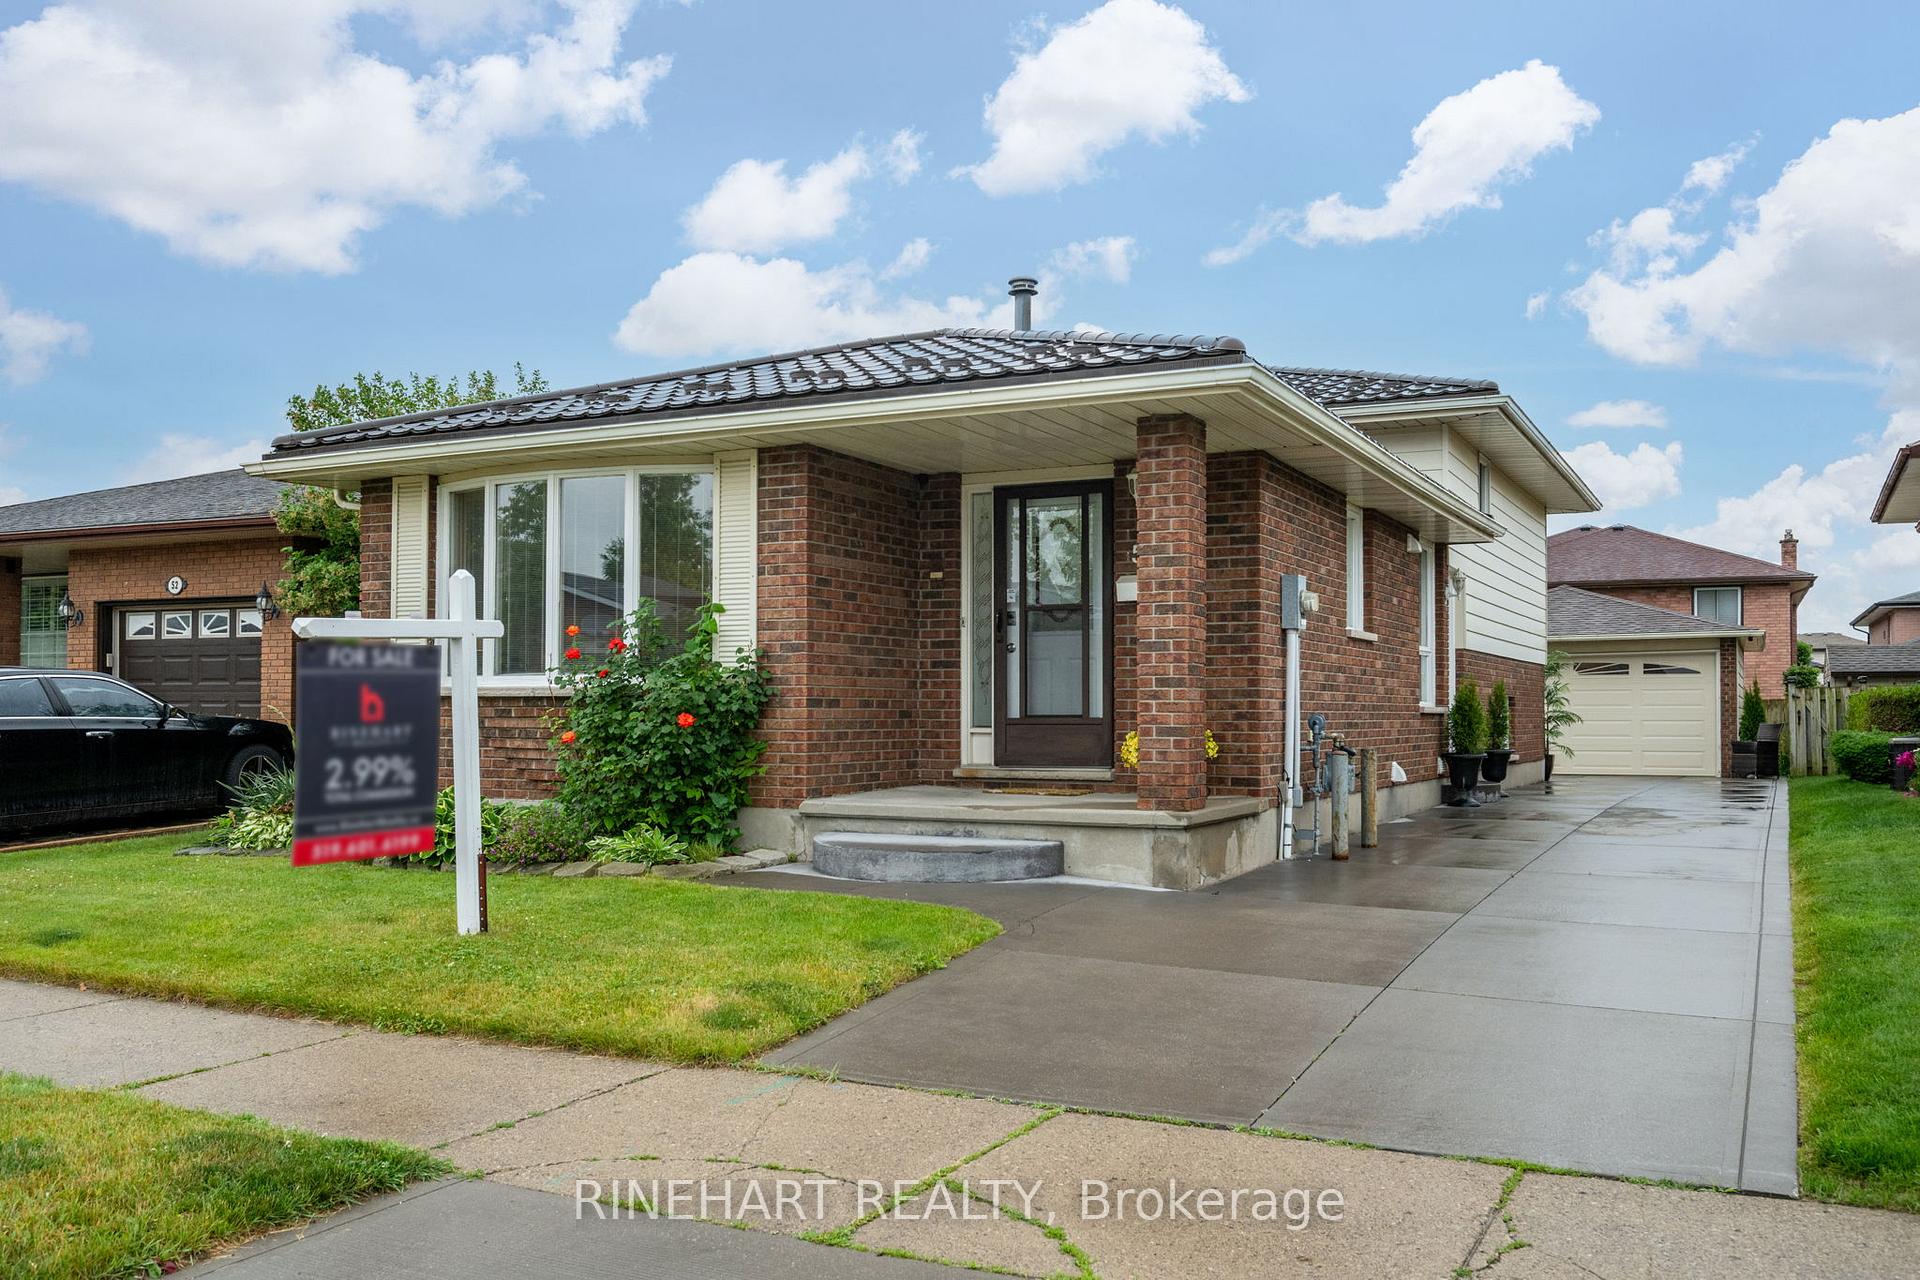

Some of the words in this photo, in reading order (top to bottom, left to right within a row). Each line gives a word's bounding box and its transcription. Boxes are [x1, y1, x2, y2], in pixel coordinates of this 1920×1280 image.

[171, 580, 179, 590] 52
[328, 647, 367, 667] FOR
[371, 647, 414, 668] SALE
[325, 756, 417, 791] 2.99%
